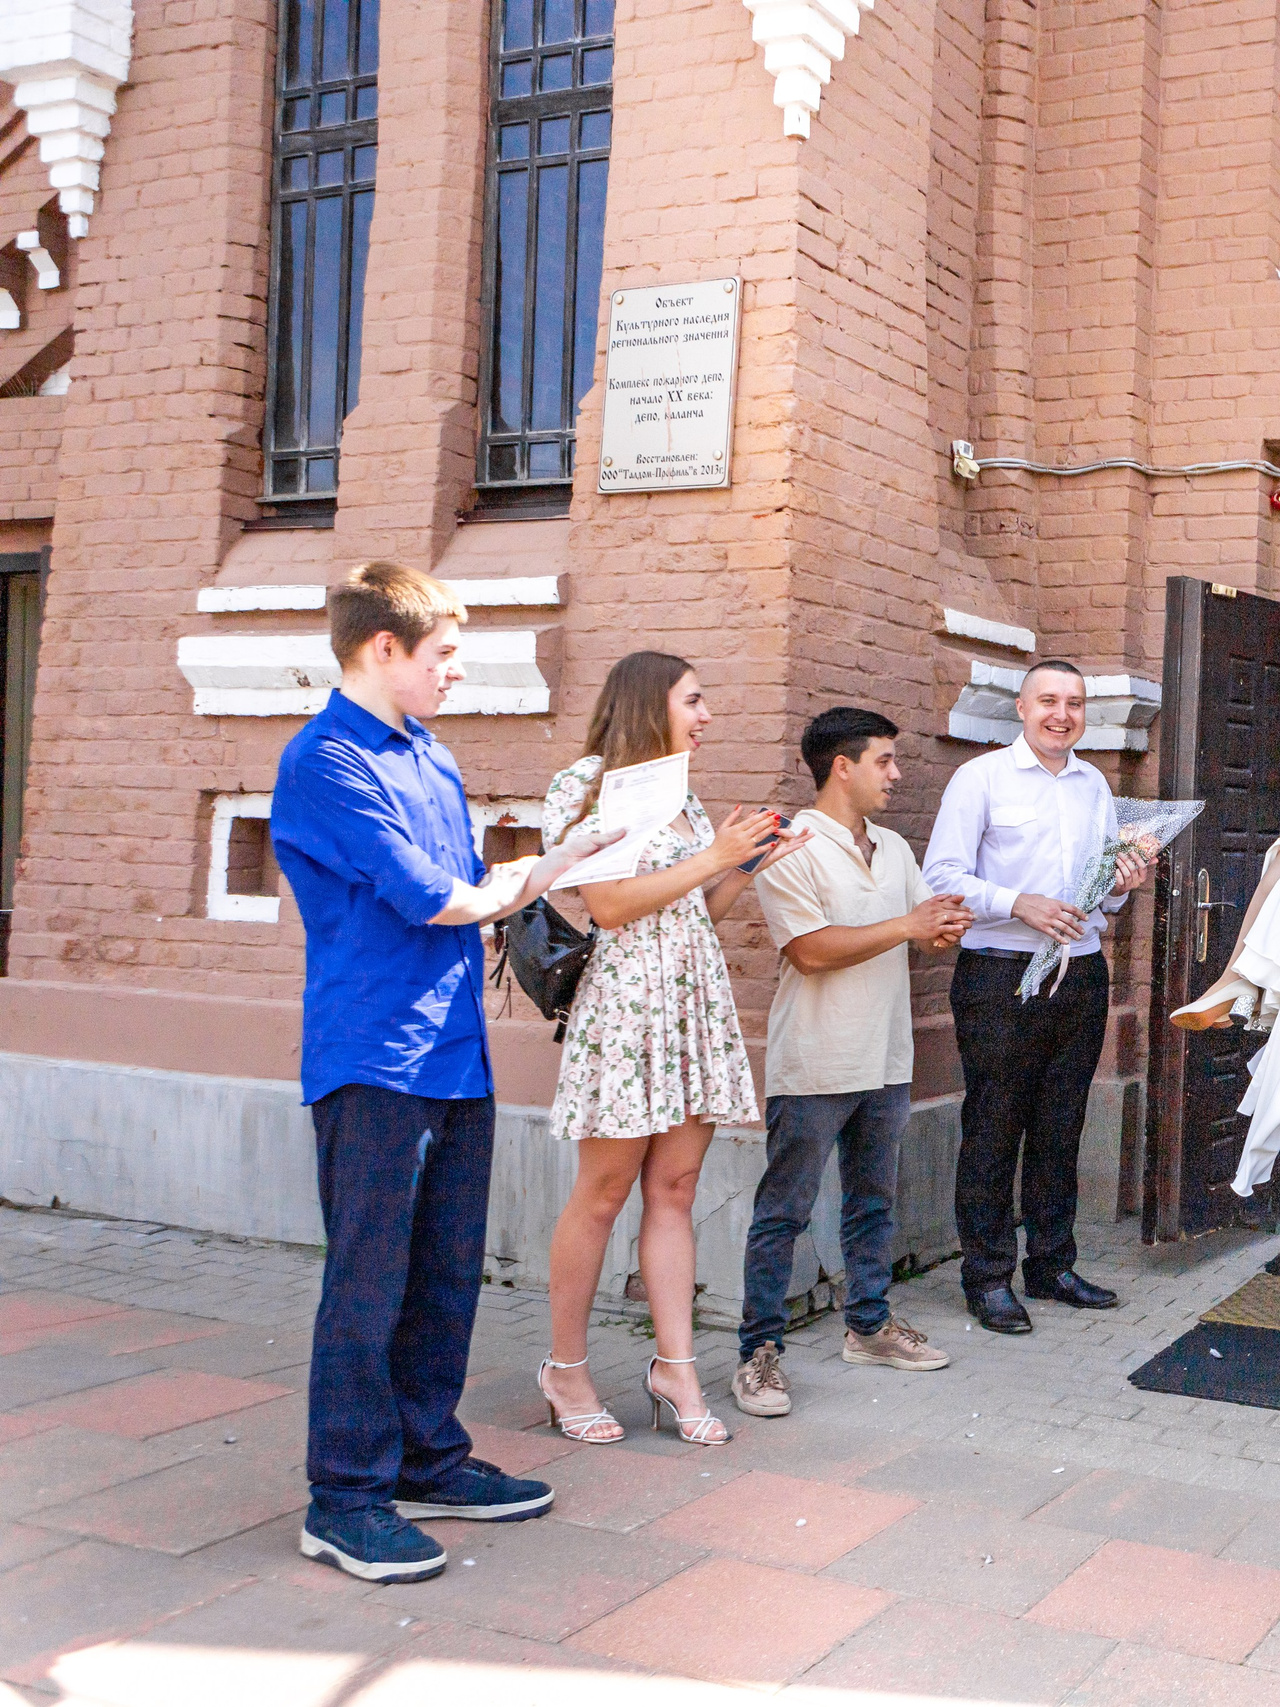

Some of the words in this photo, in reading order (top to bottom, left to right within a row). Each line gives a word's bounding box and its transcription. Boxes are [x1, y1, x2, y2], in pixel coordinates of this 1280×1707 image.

[655, 297, 694, 309] Объект
[616, 317, 679, 334] Культурного
[683, 312, 730, 326] наследия
[611, 334, 679, 352] регионального
[682, 330, 729, 343] значения
[608, 378, 650, 390] Комплекс
[629, 395, 663, 406] начало
[687, 391, 714, 401] века:
[636, 453, 698, 464] Восстановлен:
